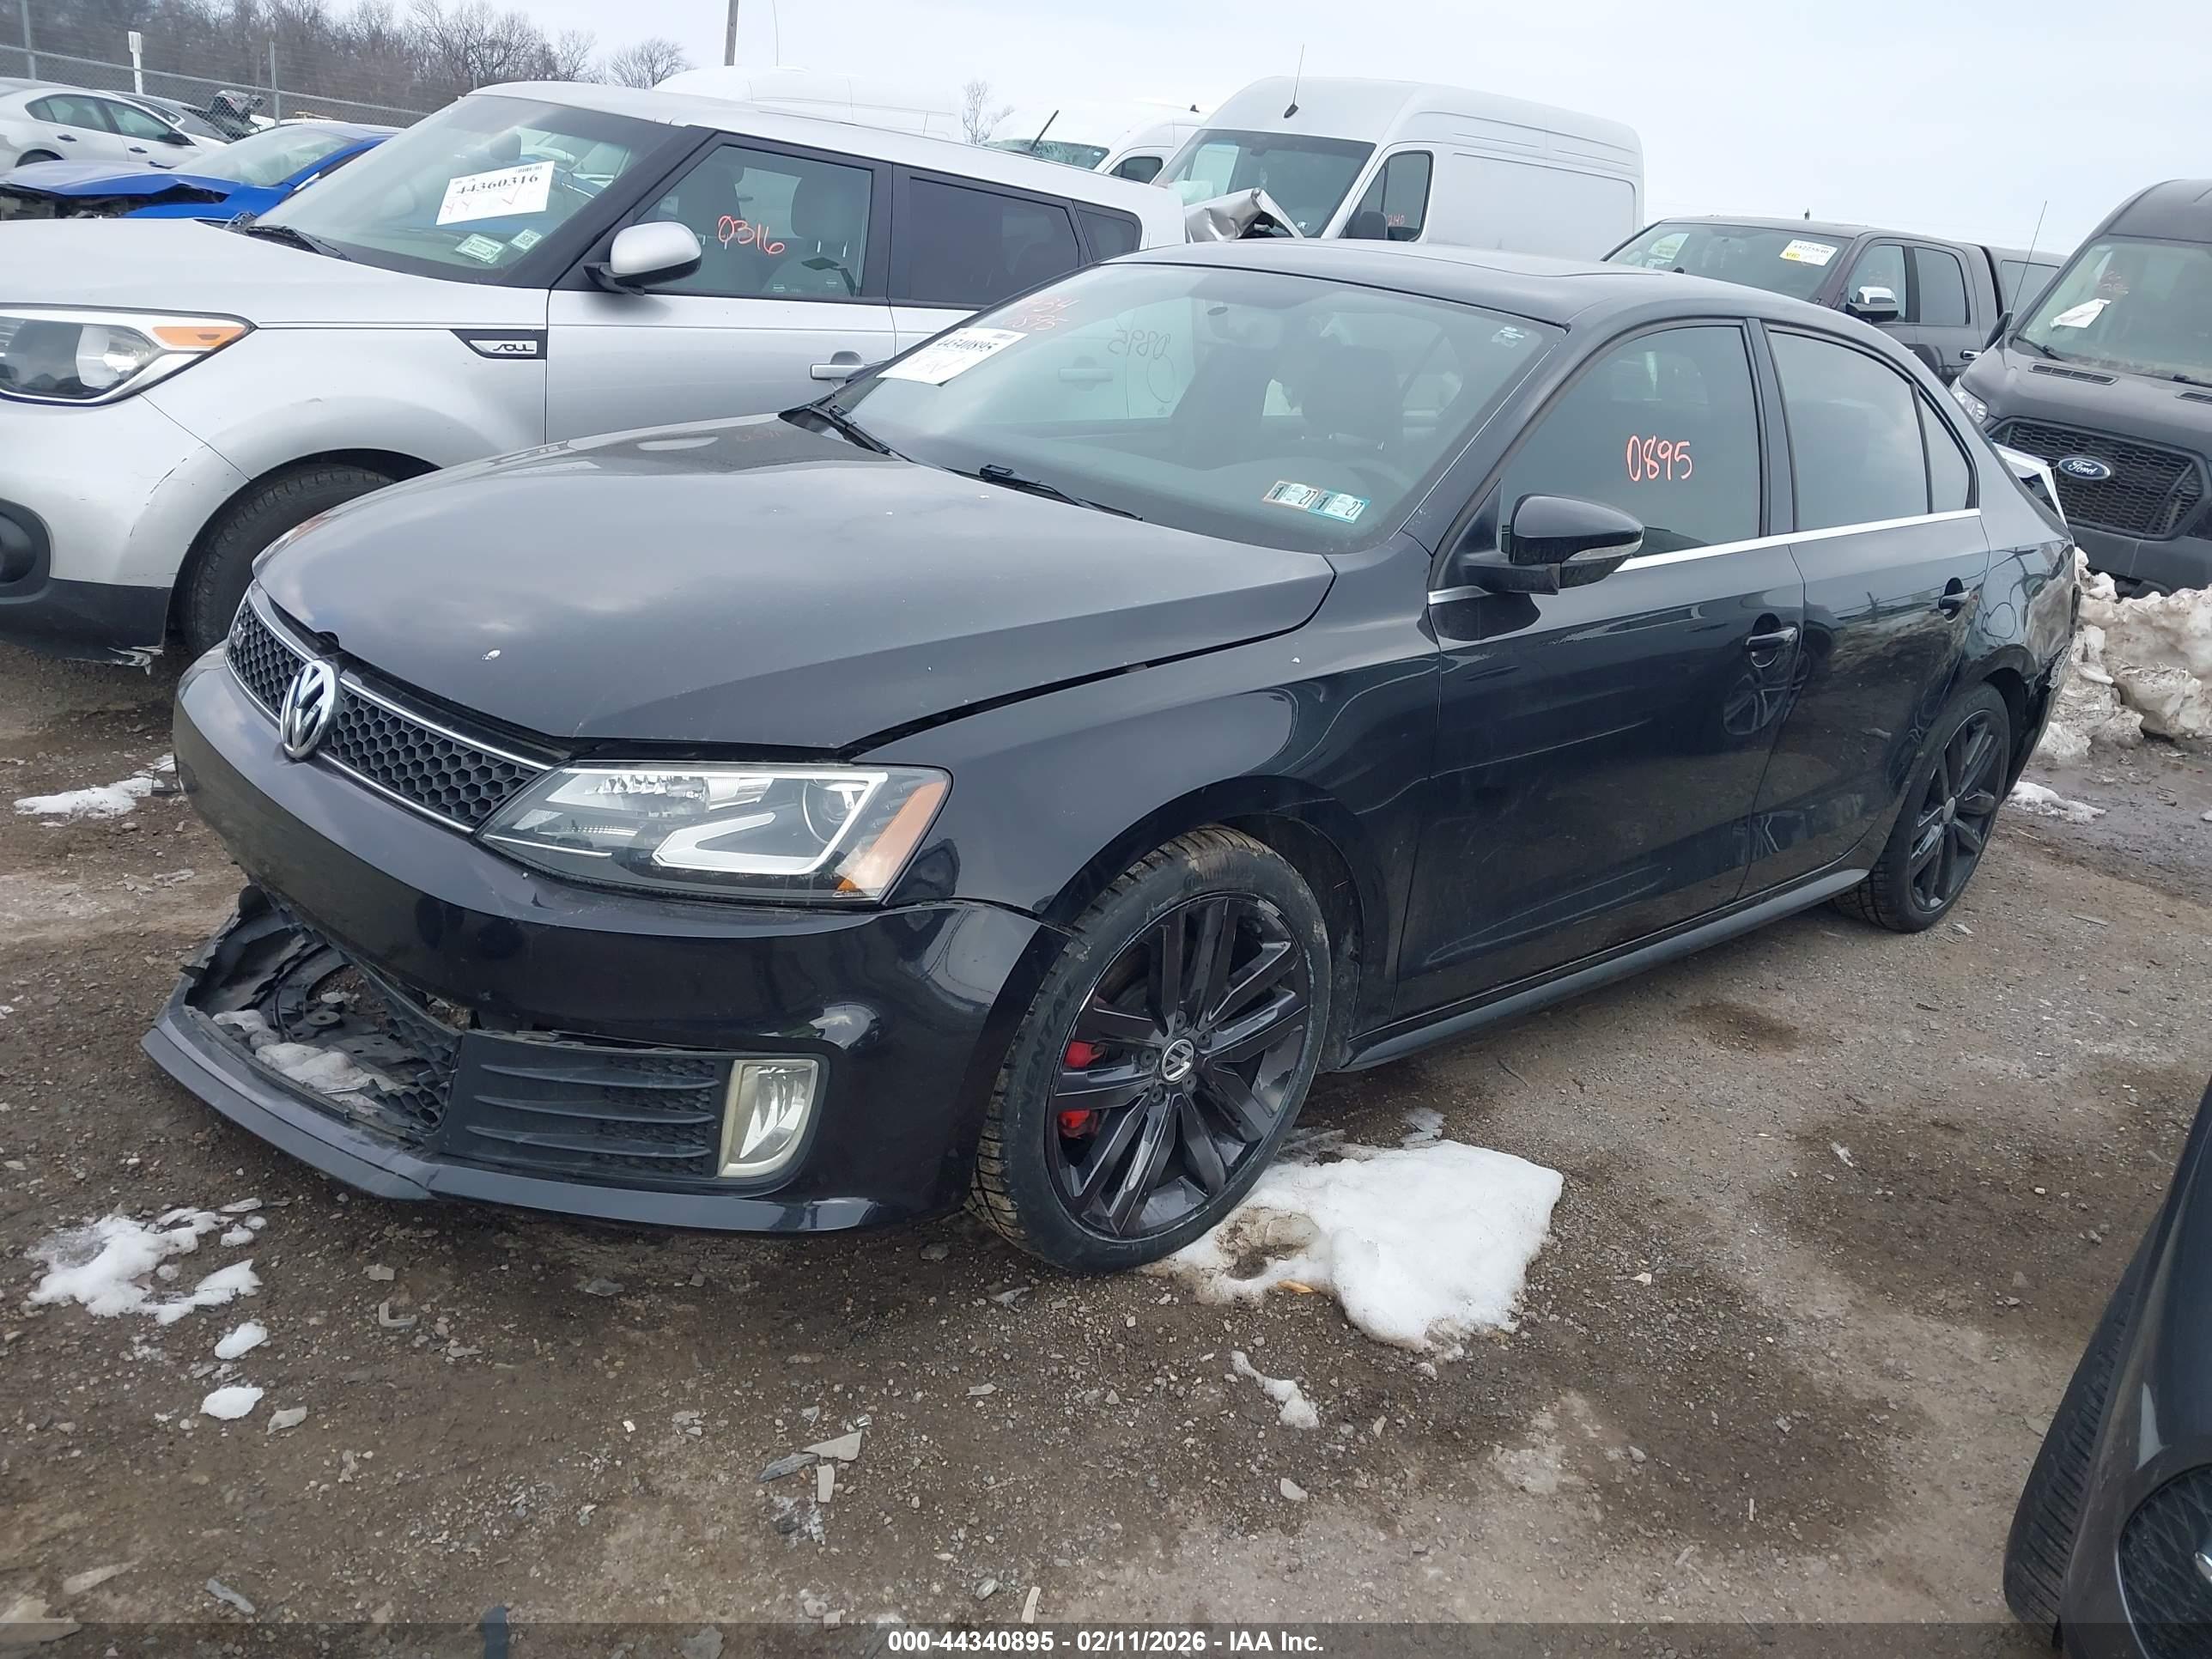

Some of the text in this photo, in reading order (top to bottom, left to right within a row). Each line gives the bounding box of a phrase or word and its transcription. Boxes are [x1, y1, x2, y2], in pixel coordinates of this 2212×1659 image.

[456, 173, 539, 195] 44360316
[718, 216, 786, 255] 0316
[1627, 434, 1693, 482] 0895
[2068, 460, 2099, 476] Ford
[1297, 489, 1317, 507] 27
[1345, 501, 1364, 518] 27
